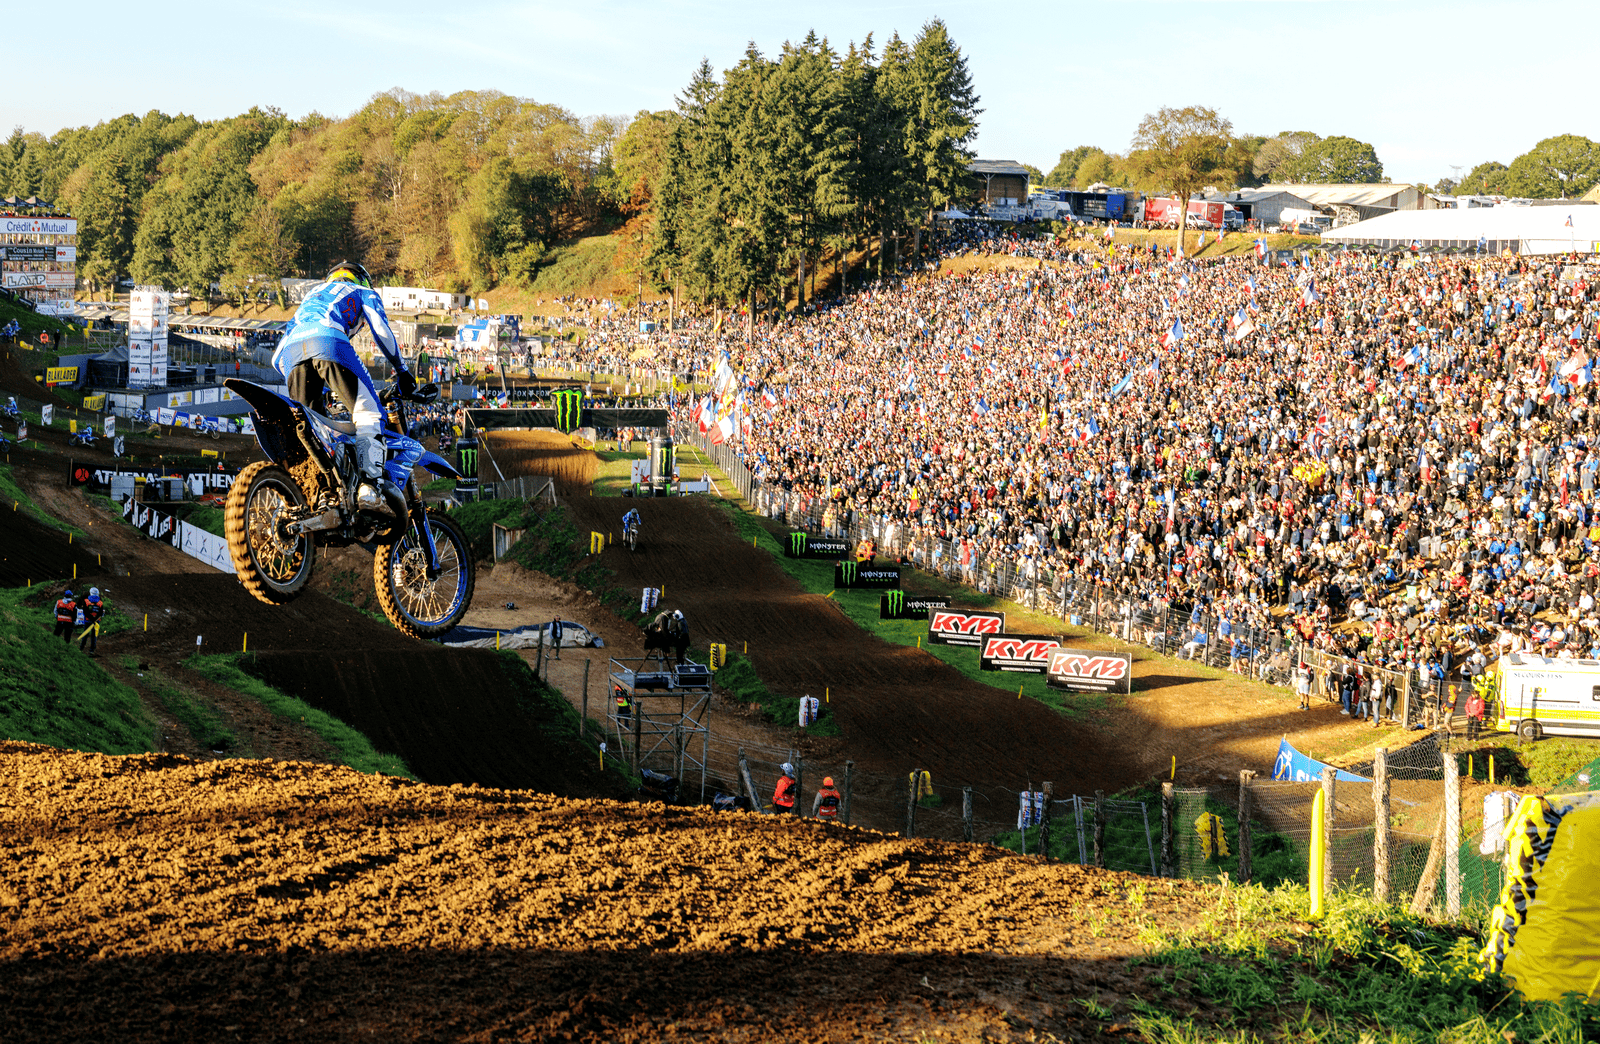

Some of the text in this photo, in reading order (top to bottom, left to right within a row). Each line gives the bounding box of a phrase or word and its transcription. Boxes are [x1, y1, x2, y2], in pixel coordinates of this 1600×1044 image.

[7, 221, 68, 232] Crédit Mutuel
[809, 542, 846, 551] MONSTER
[907, 601, 947, 609] MONSTER
[930, 612, 1002, 635] KYB
[982, 637, 1060, 661] KYB
[1049, 653, 1128, 679] KYB
